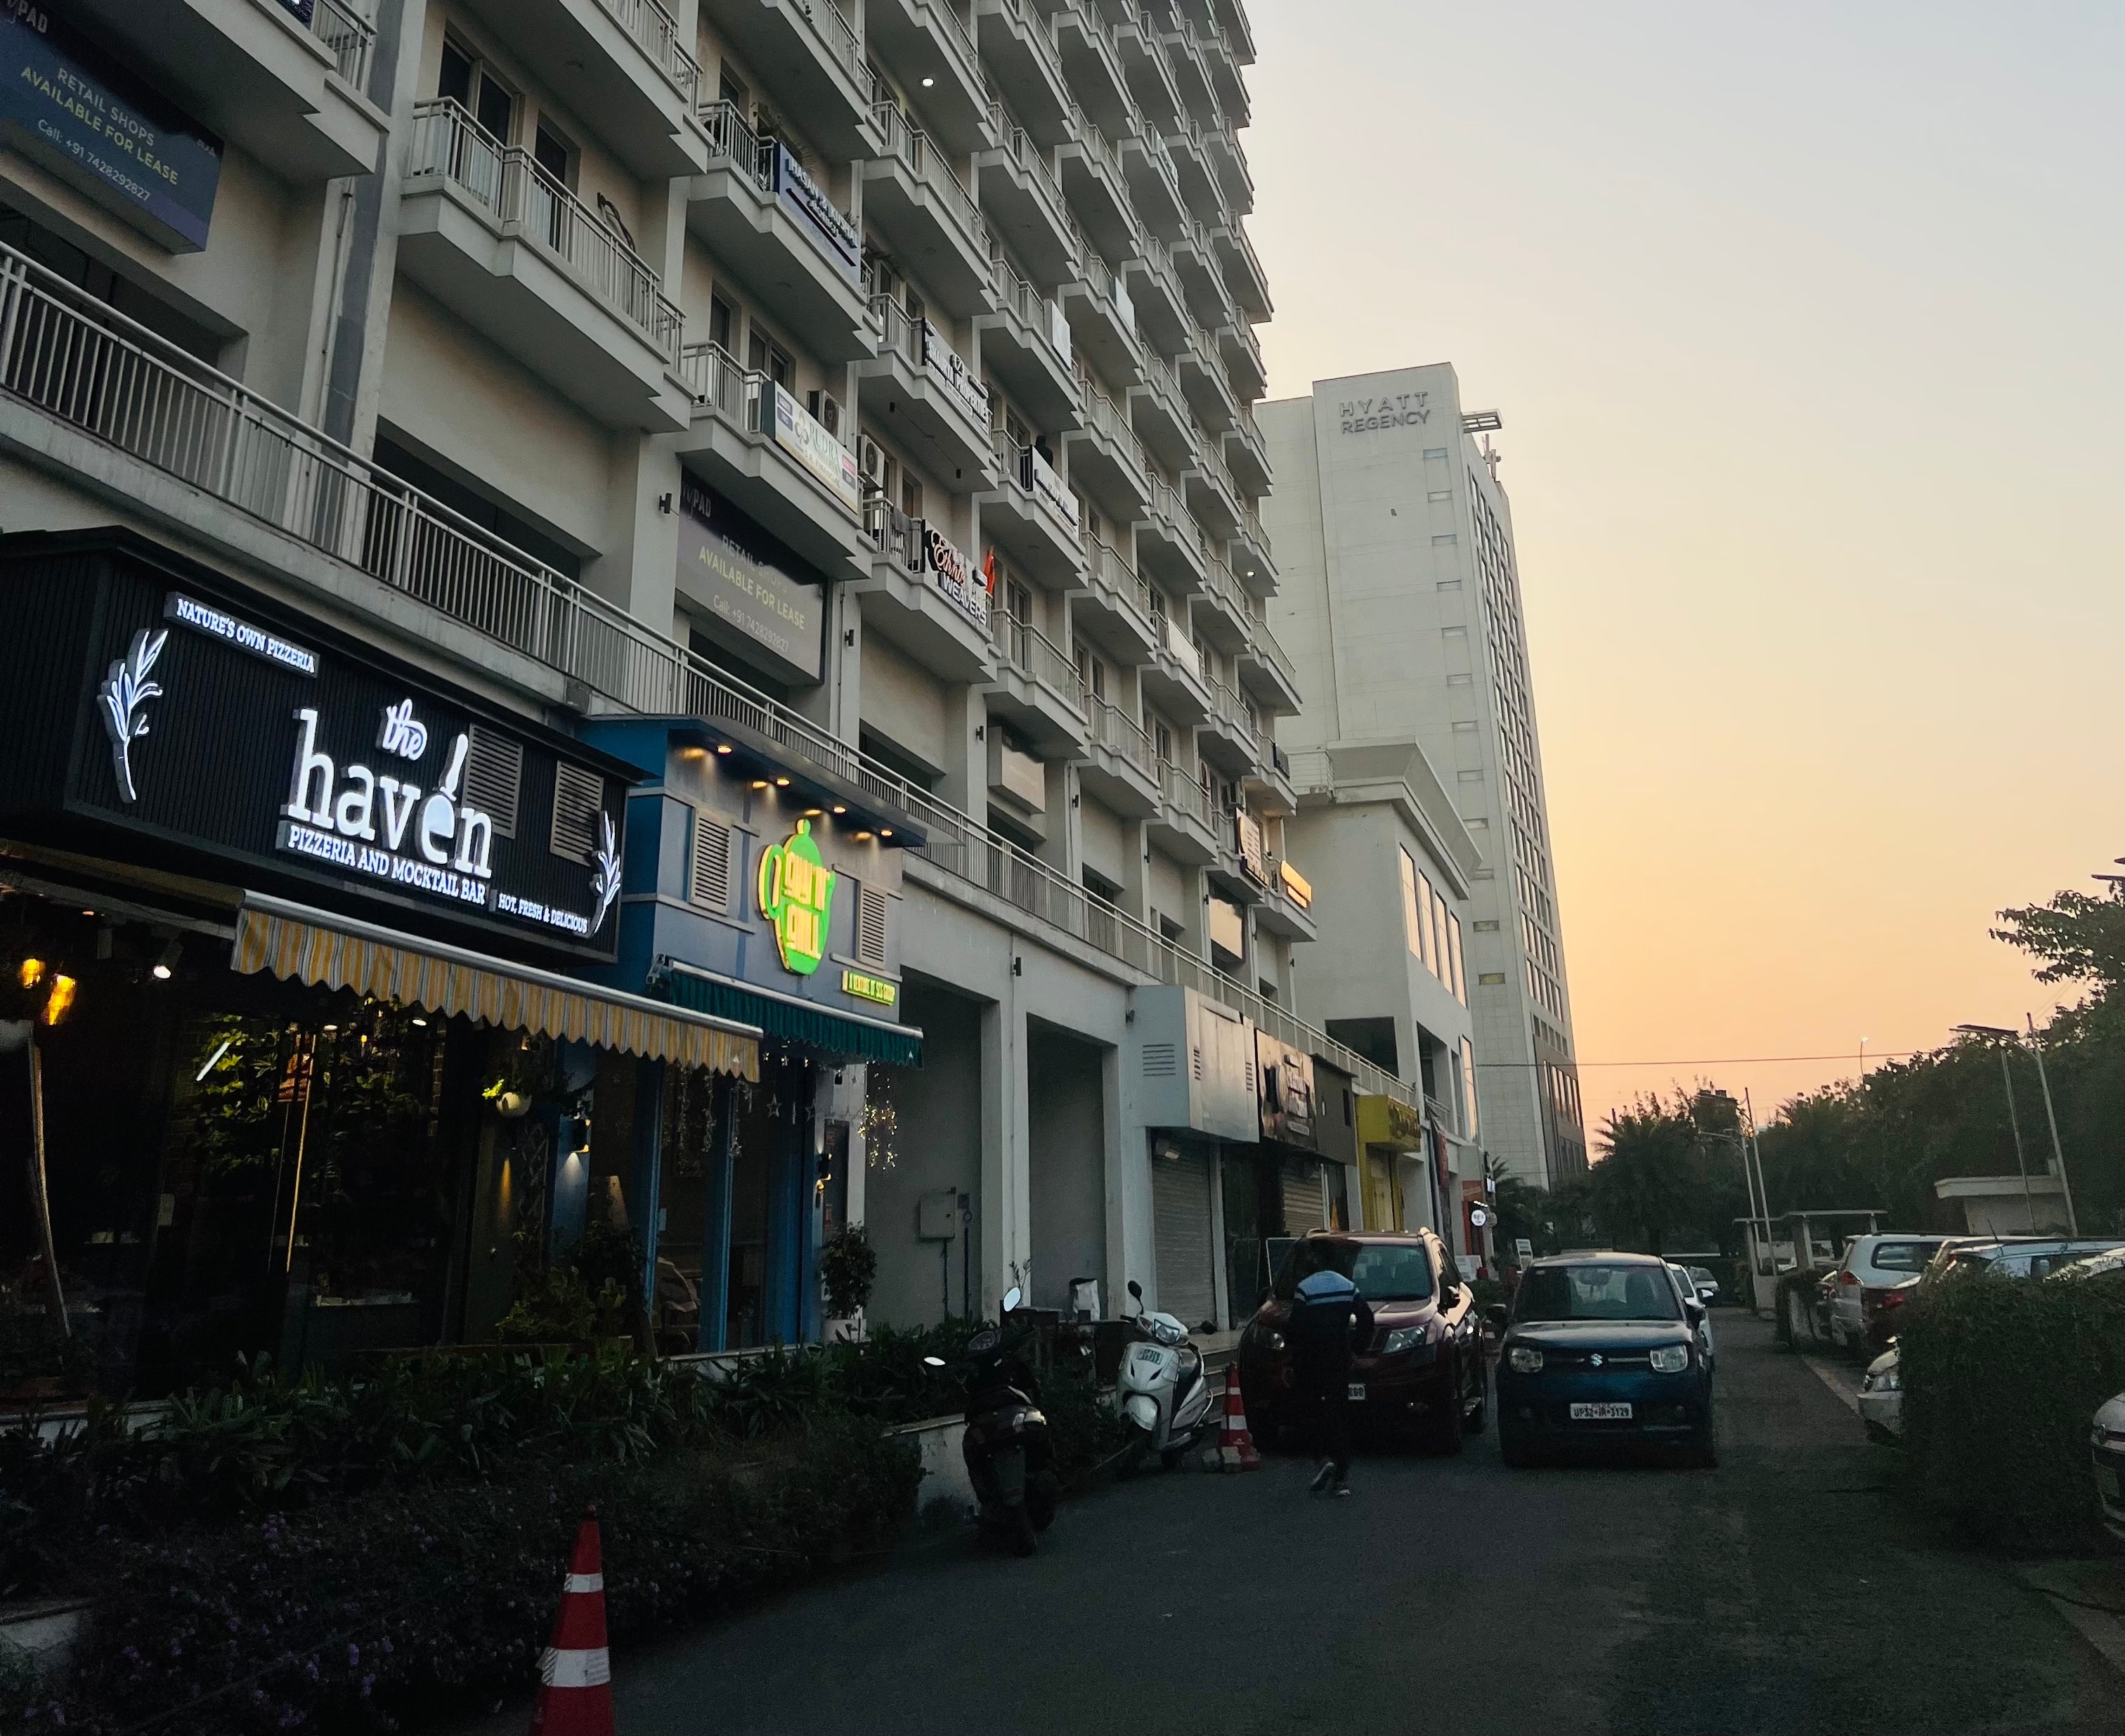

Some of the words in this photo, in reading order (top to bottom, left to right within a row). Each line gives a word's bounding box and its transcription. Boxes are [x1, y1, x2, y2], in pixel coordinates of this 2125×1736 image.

[21, 66, 103, 131] AVAILABLE
[105, 125, 134, 154] FOR
[137, 146, 178, 186] LEASE
[37, 119, 62, 144] Call:
[57, 68, 106, 113] RETAIL
[110, 107, 155, 147] SHOPS
[1339, 391, 1428, 417] HYATT
[1341, 409, 1431, 434] REGENCY
[722, 534, 755, 572] RETAIL
[698, 545, 754, 597] AVAILABLE
[755, 584, 776, 611] FOR
[777, 599, 805, 630] LEASE
[942, 571, 987, 626] WEAVERS
[176, 598, 236, 638] NATURE'S
[236, 625, 267, 652] OWN
[266, 637, 315, 673] PIZZERIA
[382, 699, 428, 760] the
[287, 708, 493, 879] haven
[287, 824, 356, 867] PIZZERIA
[357, 847, 390, 876] AND
[391, 856, 460, 898] MOCKTAIL
[460, 879, 487, 906] BAR
[498, 892, 517, 914] HOT,
[517, 899, 544, 921] FRESH
[542, 907, 551, 923] &
[550, 909, 588, 934] DELICIOUS
